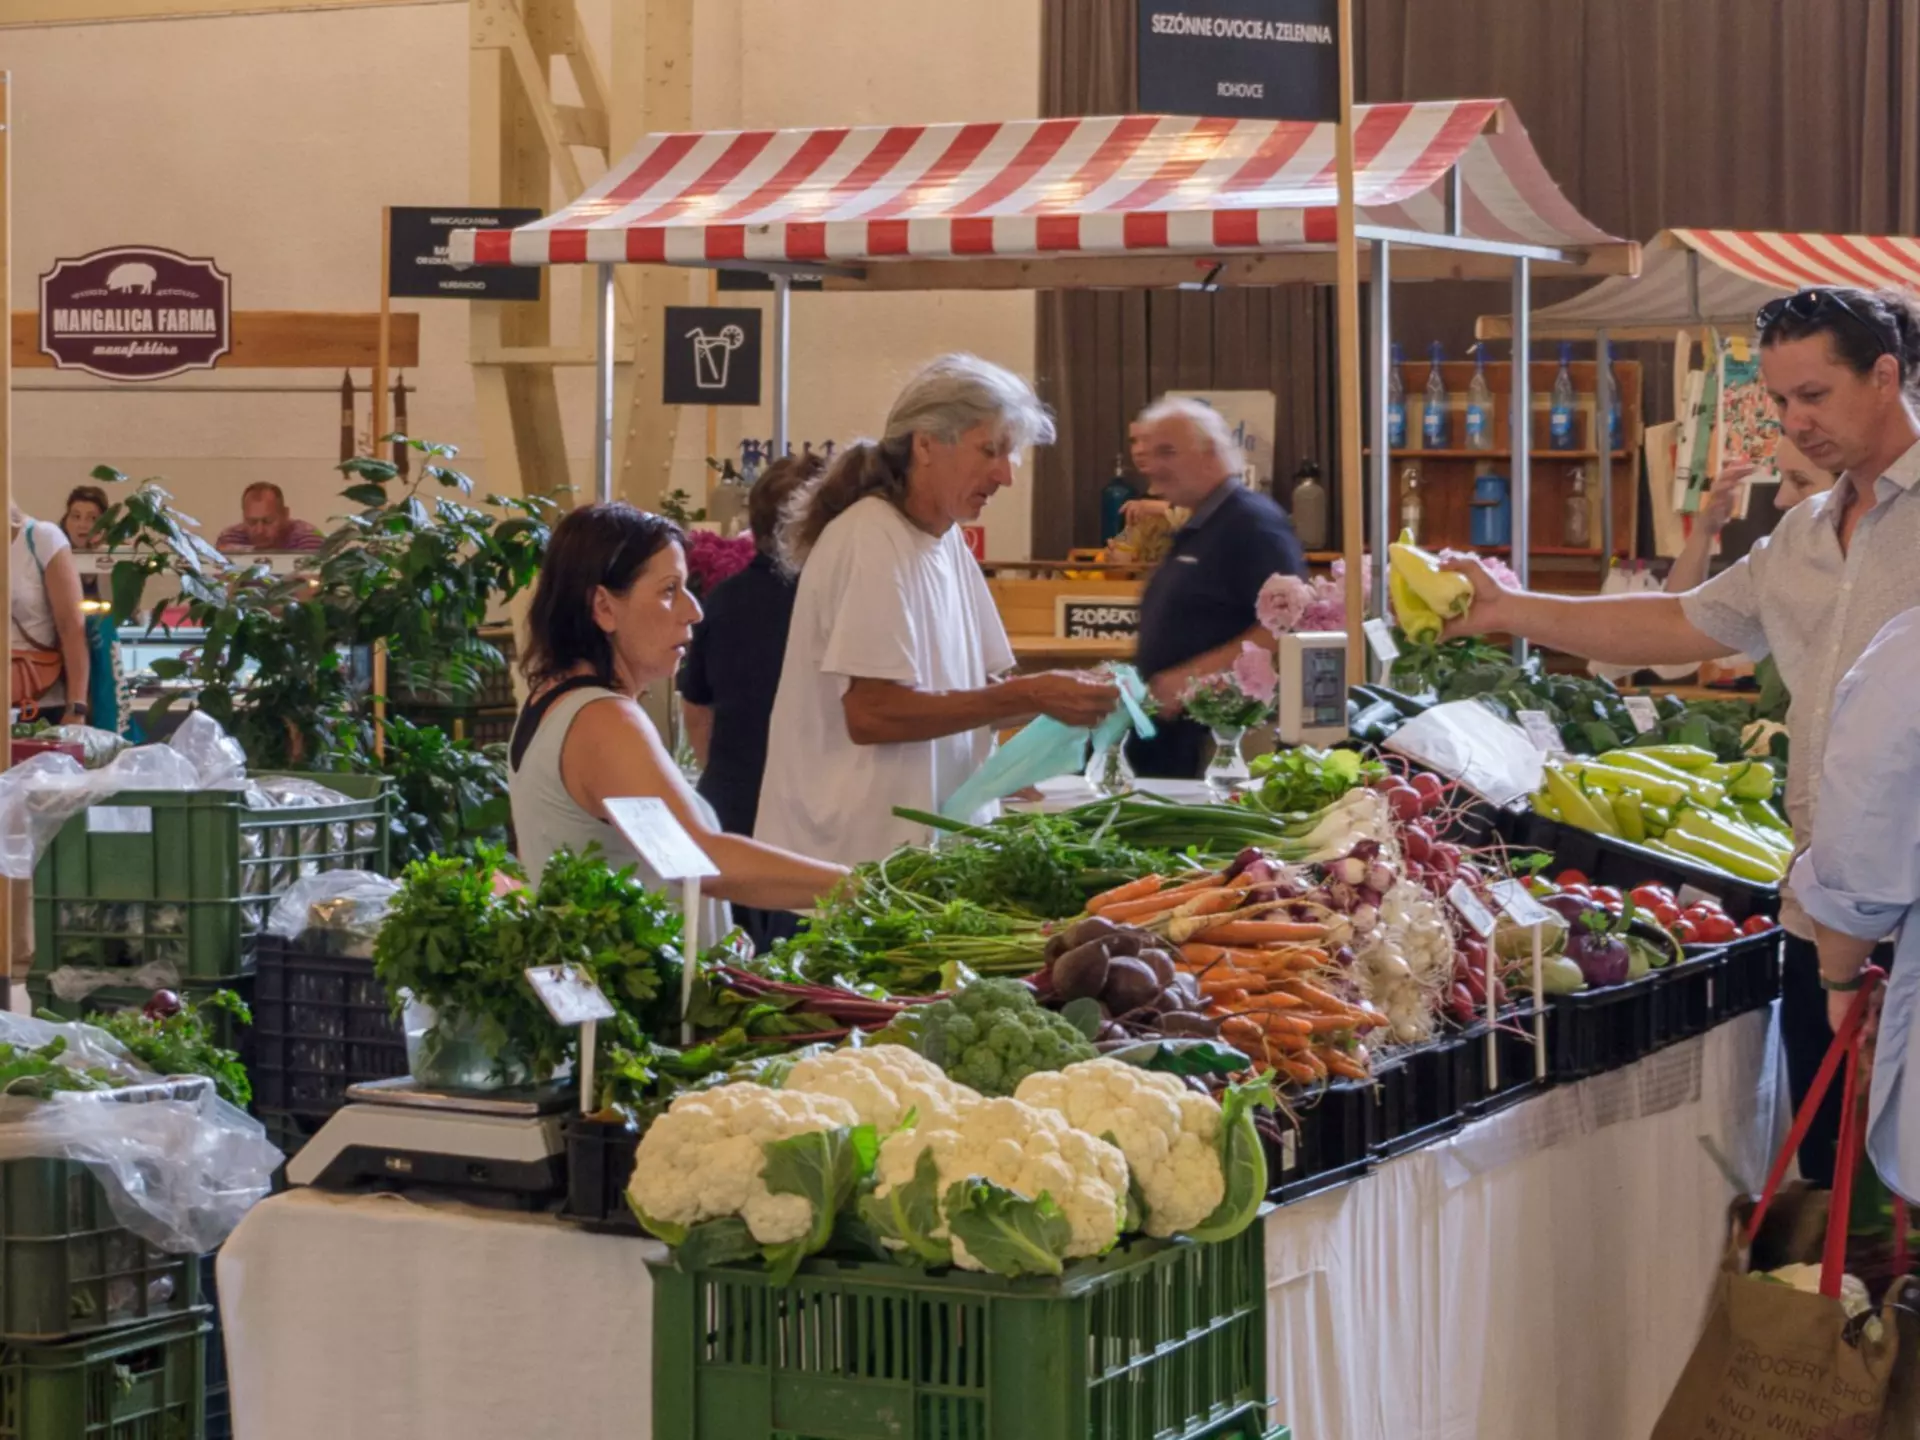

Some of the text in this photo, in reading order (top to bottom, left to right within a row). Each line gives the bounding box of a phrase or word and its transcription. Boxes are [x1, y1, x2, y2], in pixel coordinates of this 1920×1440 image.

[1152, 13, 1332, 44] SEZÓNNE OVOCIE A ZELENINA
[1217, 82, 1264, 98] ROHOVCE
[53, 308, 216, 332] MANGALICA FARMA
[1755, 1382, 1843, 1424] MARKET
[1832, 1376, 1881, 1408] SHO
